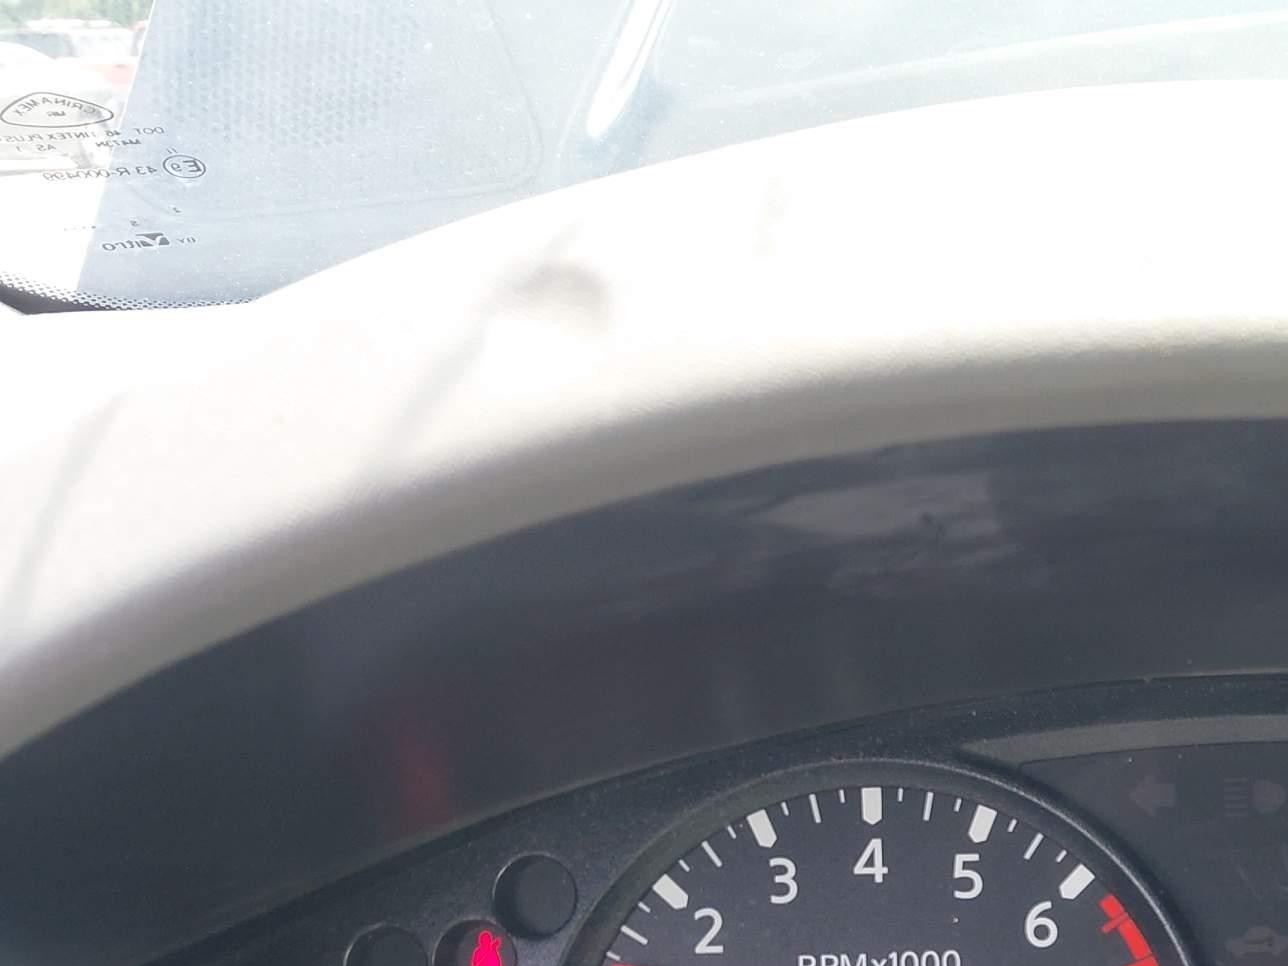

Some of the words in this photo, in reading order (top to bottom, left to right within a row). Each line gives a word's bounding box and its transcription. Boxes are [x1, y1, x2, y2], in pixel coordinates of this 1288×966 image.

[770, 858, 797, 903] 3
[854, 839, 888, 882] 4
[954, 854, 982, 898] 5
[695, 908, 723, 953] 2
[1026, 901, 1057, 947] 6
